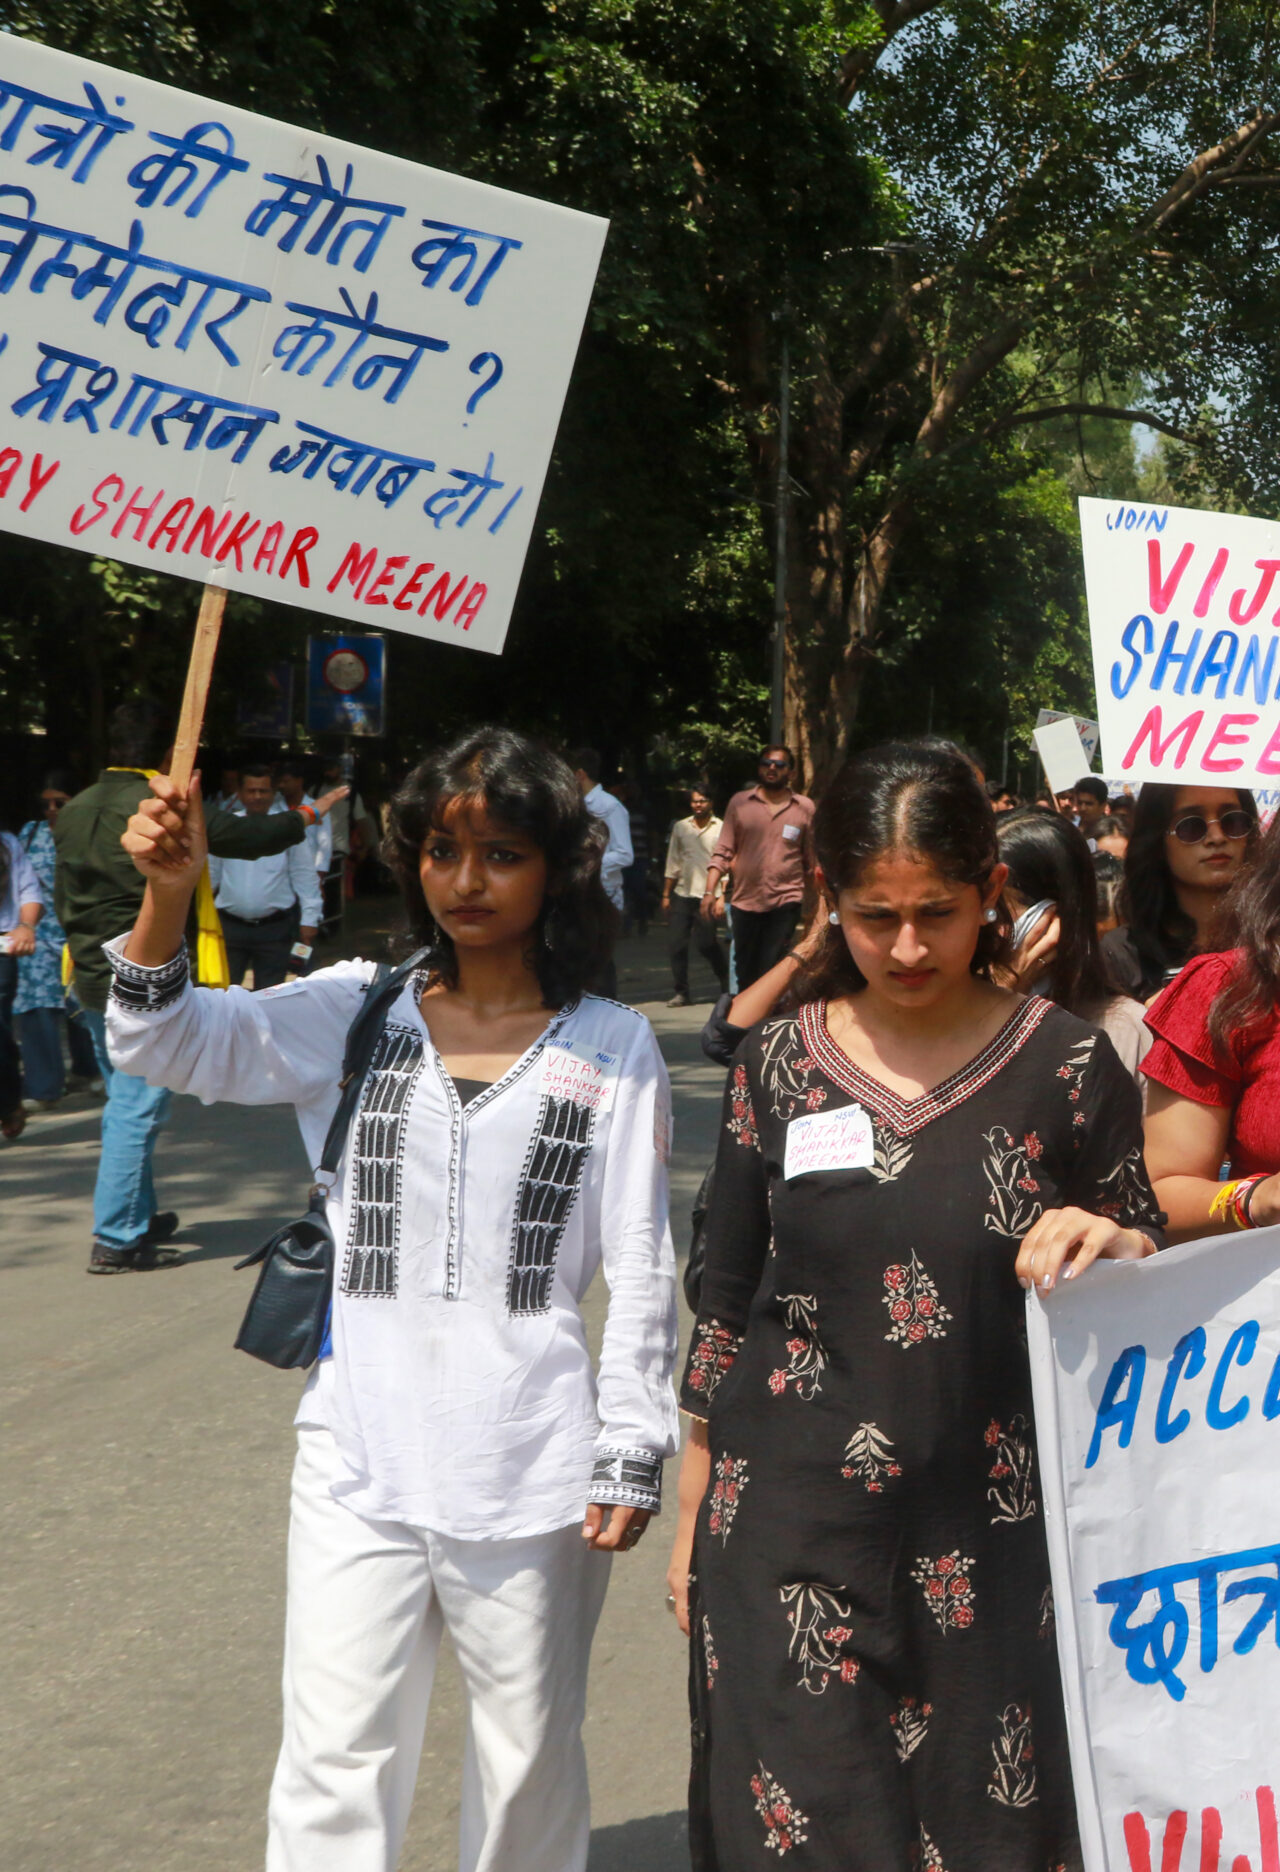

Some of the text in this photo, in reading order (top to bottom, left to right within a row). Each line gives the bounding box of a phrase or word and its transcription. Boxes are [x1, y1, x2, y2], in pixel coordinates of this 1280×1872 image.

[127, 121, 250, 218] की
[245, 154, 406, 273] मौत
[412, 219, 523, 306] का
[272, 287, 450, 404] कौन
[462, 351, 504, 427] ?
[11, 341, 280, 464] प्रशासन
[269, 419, 436, 508] जवाब
[1106, 506, 1169, 533] JOIN
[69, 472, 319, 588] SHANKAR
[326, 541, 488, 631] MEENA
[547, 1053, 602, 1080] VIJAY
[542, 1072, 611, 1099] SHANKKAR
[547, 1085, 601, 1108] MEENA
[801, 1119, 850, 1141] VIJAY
[788, 1129, 868, 1161] SHANKKAR
[792, 1152, 857, 1173] MEENA
